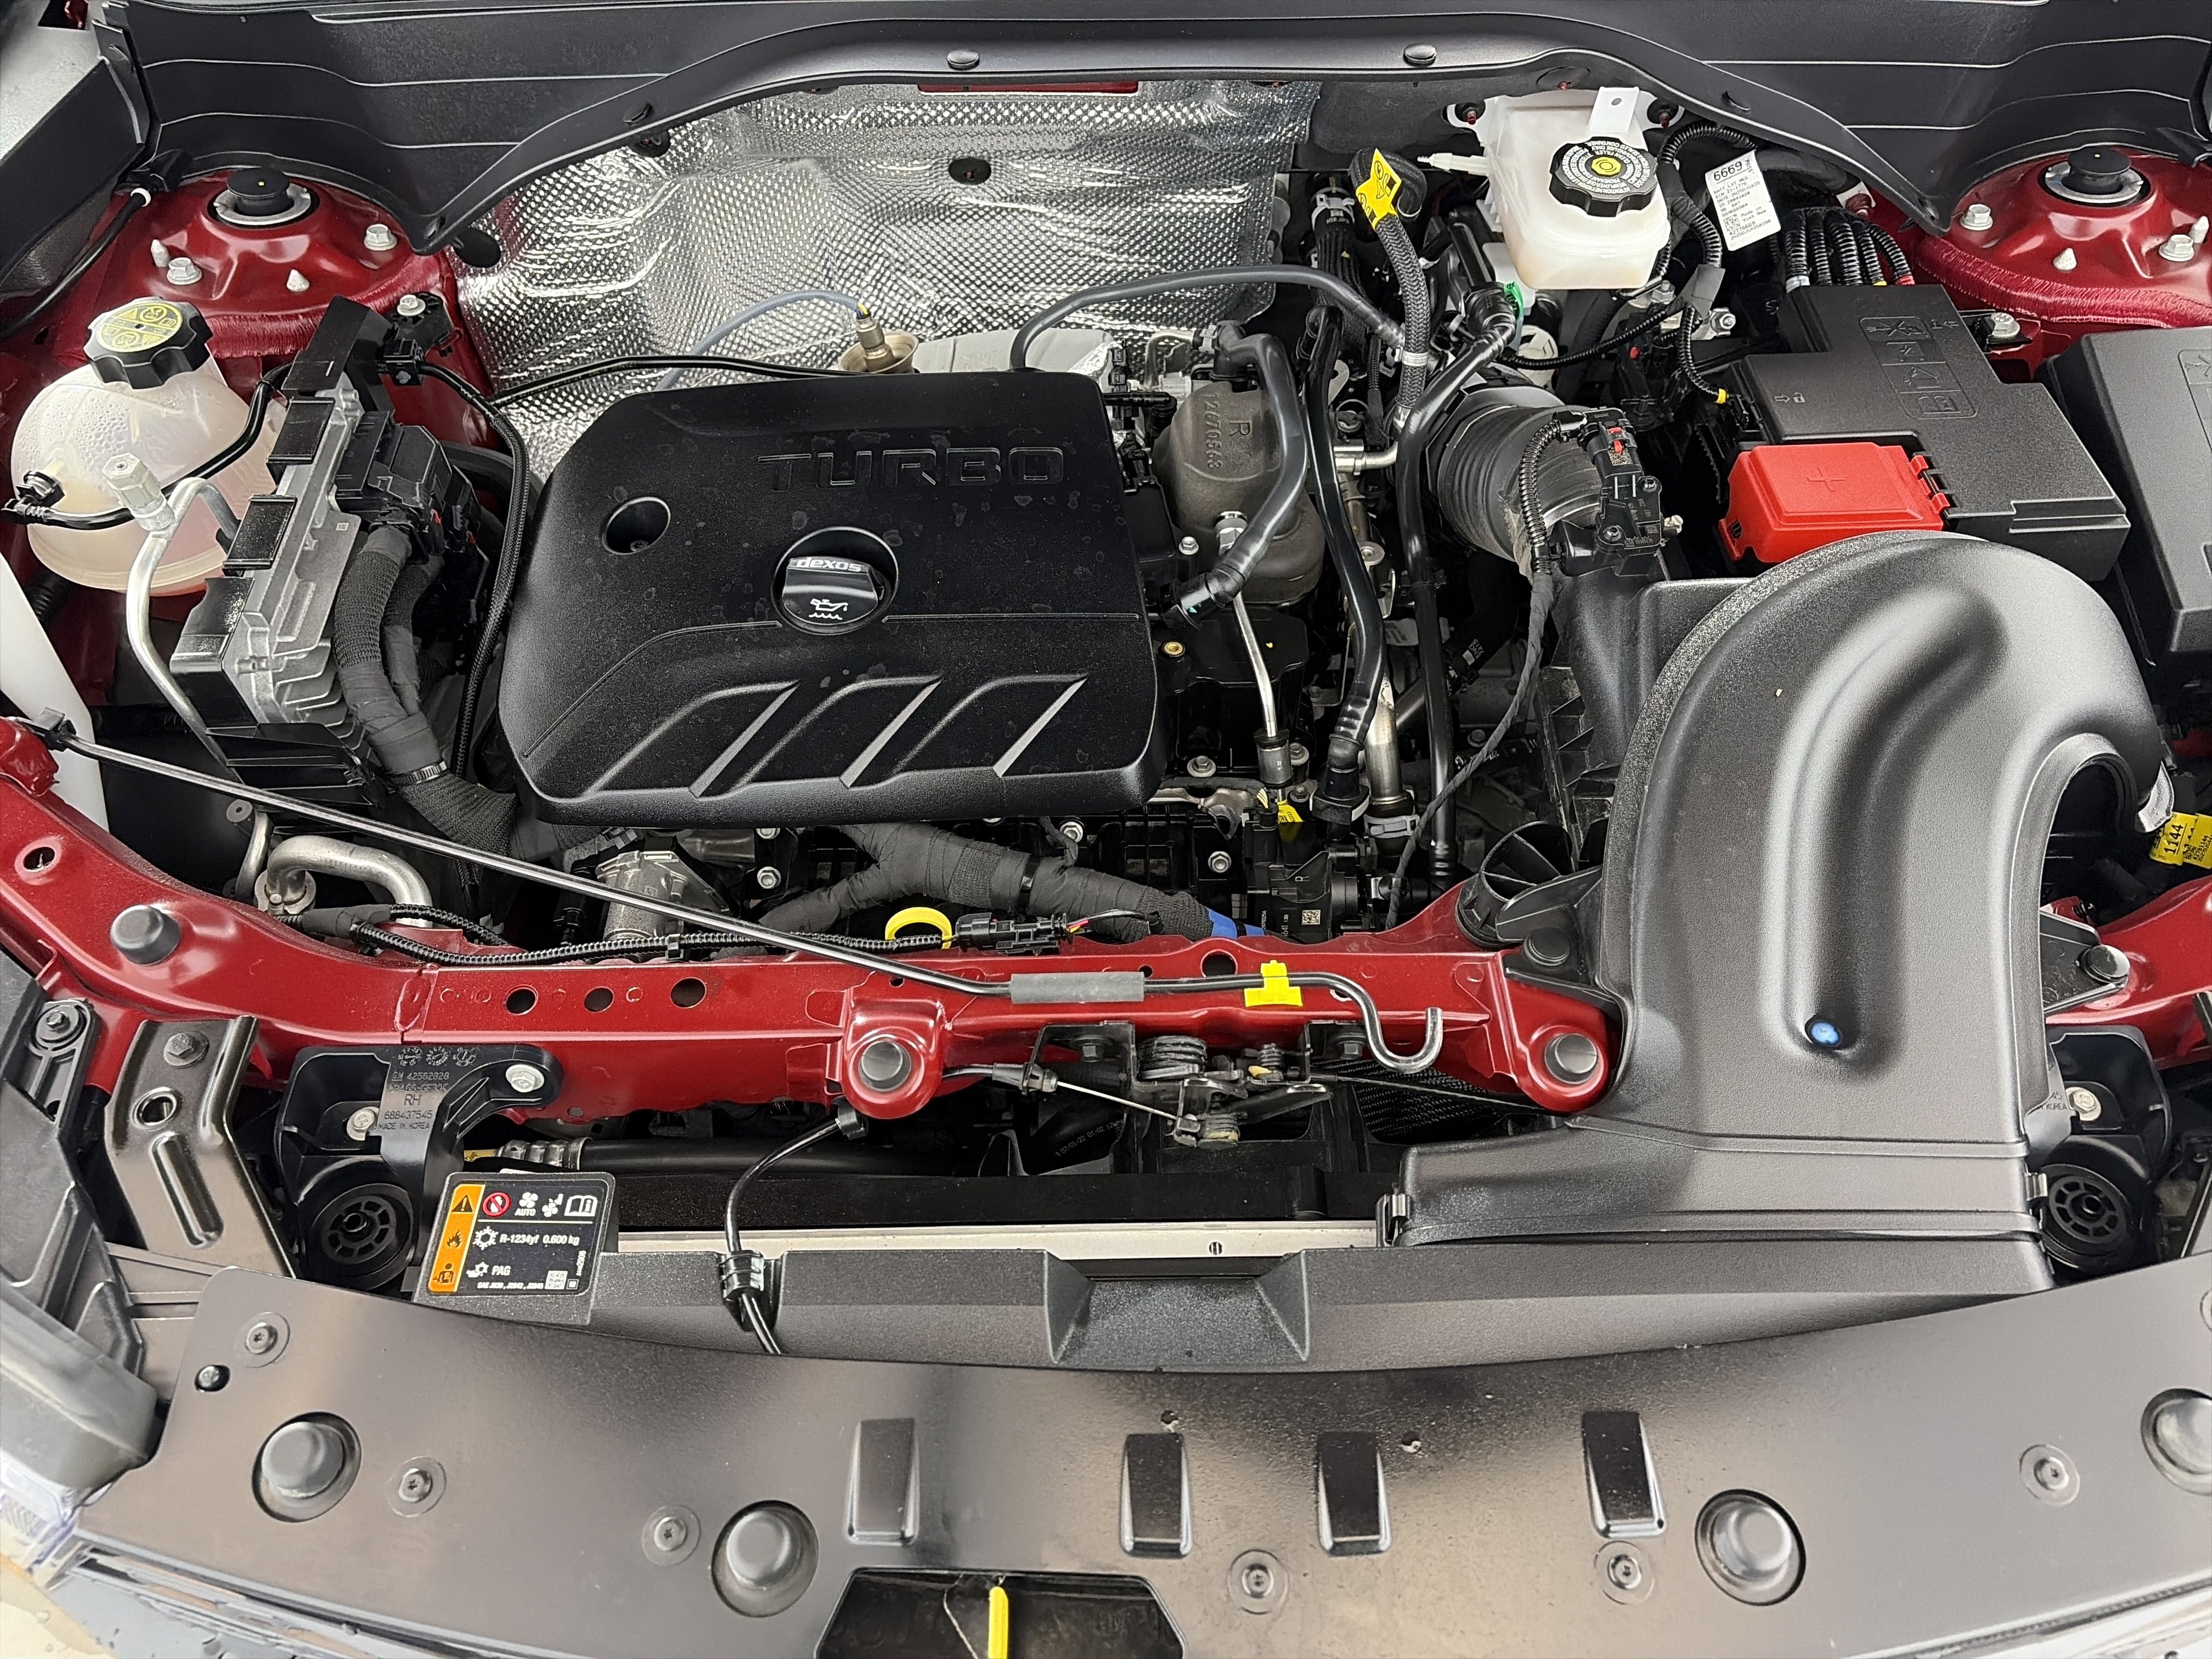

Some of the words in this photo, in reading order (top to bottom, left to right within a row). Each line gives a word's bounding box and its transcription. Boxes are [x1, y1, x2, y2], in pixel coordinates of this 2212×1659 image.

[1713, 161, 1742, 181] 6669
[1229, 419, 1252, 437] R
[758, 447, 1063, 492] TURBO
[797, 557, 862, 572] dexos
[2164, 825, 2183, 854] 1144
[404, 1093, 422, 1106] RH
[514, 1208, 536, 1216] AUTO
[499, 1234, 540, 1245] R-1234yf
[543, 1235, 567, 1244] 0.600
[568, 1235, 580, 1246] kg
[492, 1266, 511, 1276] PAG
